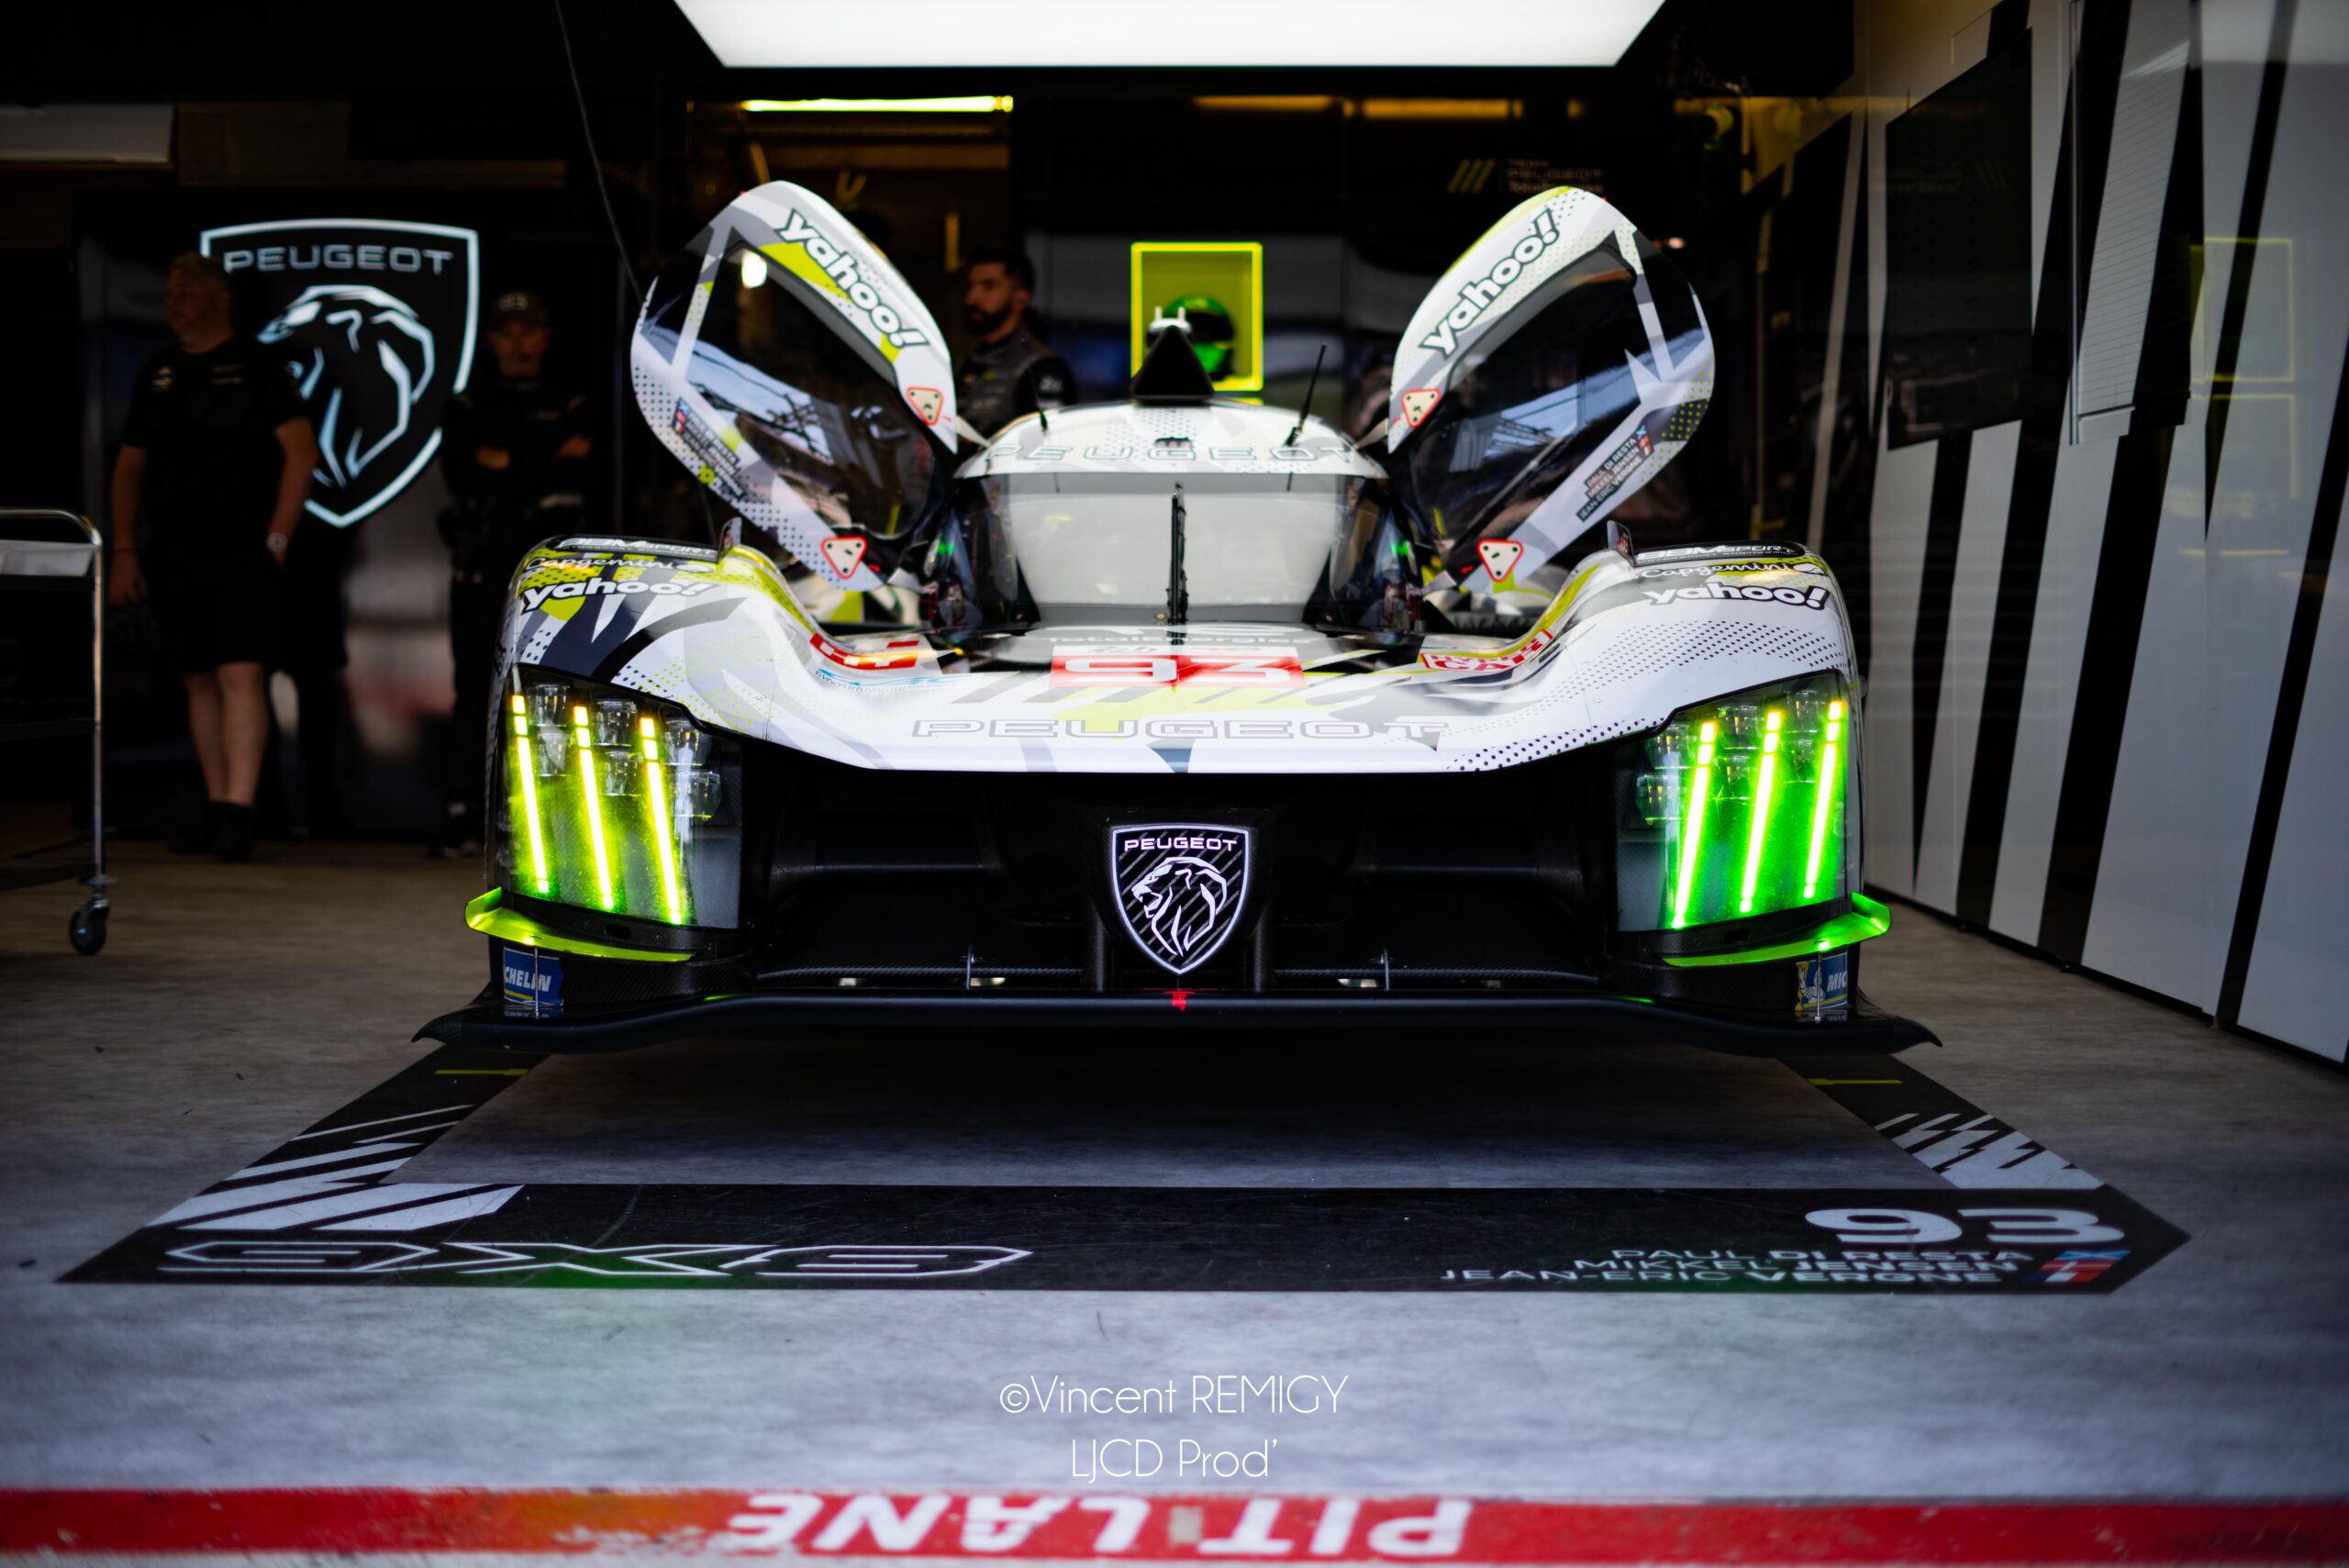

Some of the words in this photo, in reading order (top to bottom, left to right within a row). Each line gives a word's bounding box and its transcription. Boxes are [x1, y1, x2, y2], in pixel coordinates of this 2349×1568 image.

[223, 244, 453, 275] PEUGEOT
[774, 207, 930, 349] yahoo!
[1419, 206, 1560, 360] yahoo!
[987, 443, 1355, 462] PEUGEOT
[526, 558, 673, 572] Capgemini
[1641, 562, 1790, 578] Capgemini
[521, 577, 718, 615] yahoo!
[1642, 582, 1830, 610] yahoo!
[1064, 658, 1290, 684] 93
[912, 718, 1451, 740] PEUGEOT
[1124, 837, 1237, 851] PEUGEOT
[1805, 1208, 2125, 1243] 93
[1574, 1260, 1779, 1270] MIKKEL
[1796, 1261, 2019, 1271] JENSEN
[1611, 1249, 1755, 1259] PAUL
[1768, 1250, 1826, 1260] DI
[1842, 1251, 2034, 1261] RESTA
[1440, 1270, 1732, 1281] JEAN-ERIC
[1745, 1271, 2001, 1282] VERGNE
[729, 1493, 1152, 1556] LANE
[1197, 1496, 1470, 1556] PIT
